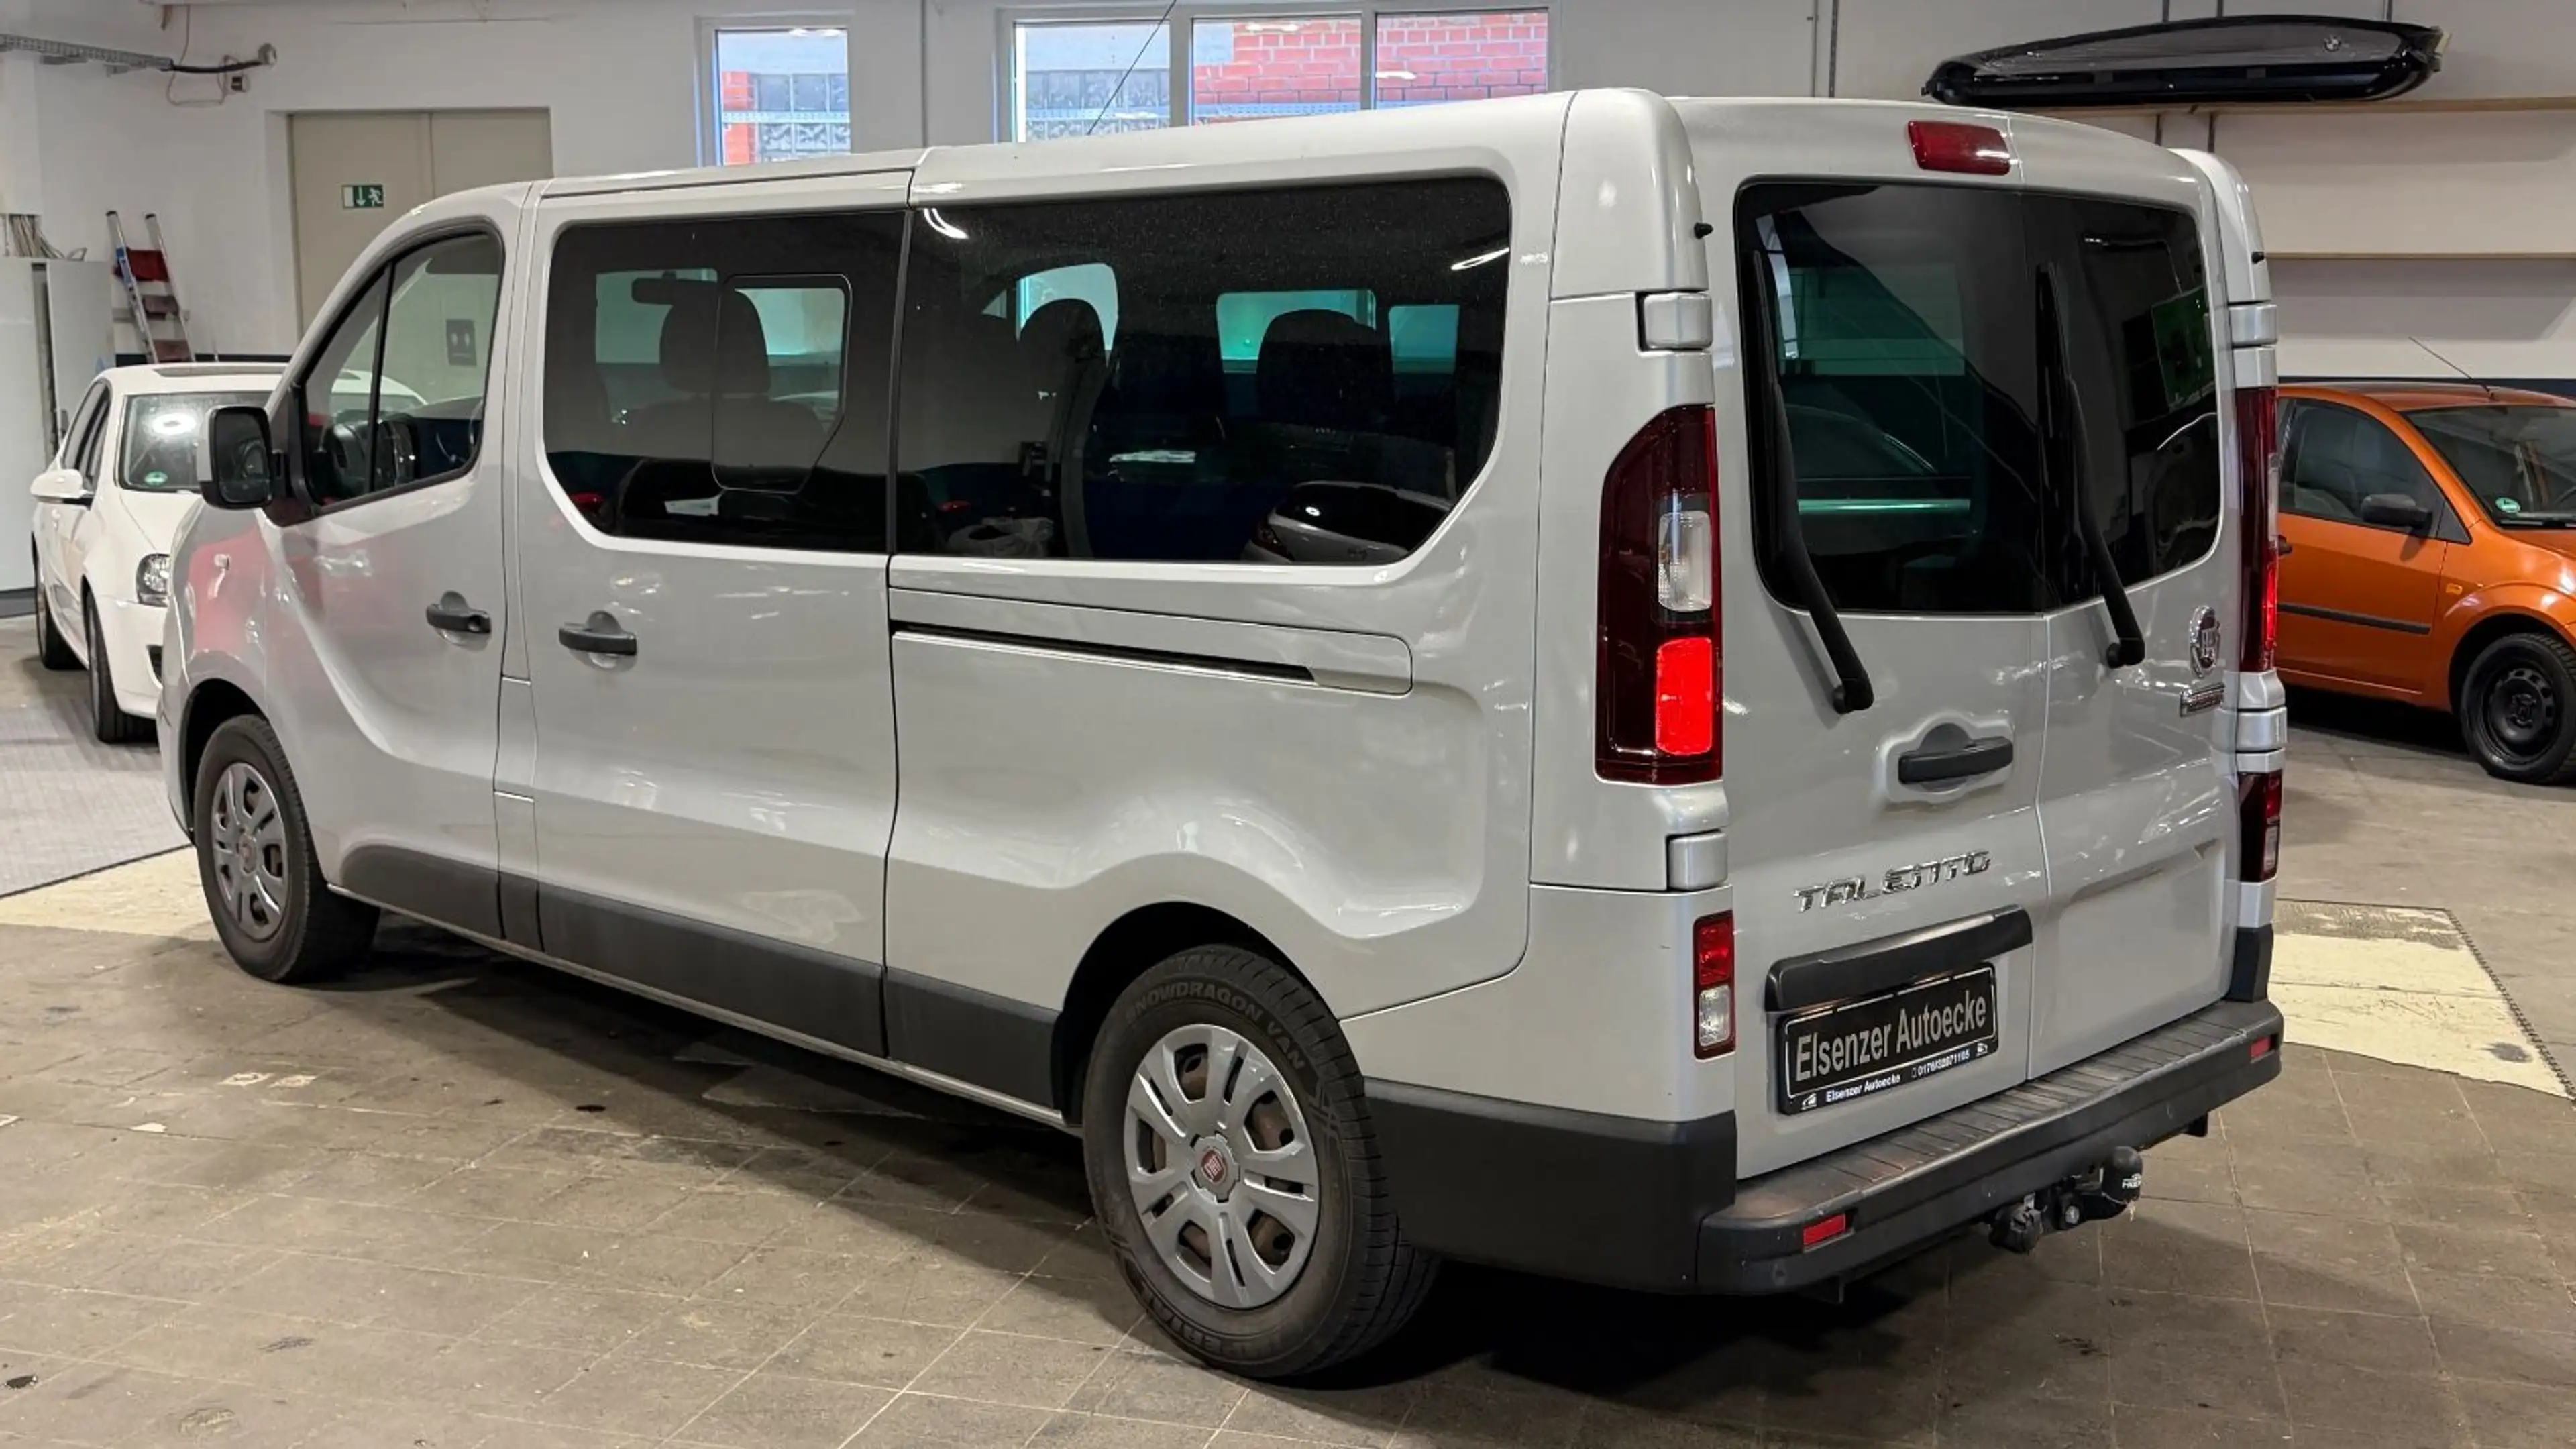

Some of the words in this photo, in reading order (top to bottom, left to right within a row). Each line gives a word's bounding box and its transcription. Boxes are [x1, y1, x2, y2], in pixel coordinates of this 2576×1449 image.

[1792, 849, 1992, 913] TALENTO
[1267, 1020, 1305, 1070] VAN
[1896, 989, 1986, 1054] Autoecke
[1864, 1073, 1901, 1092] Autoecke
